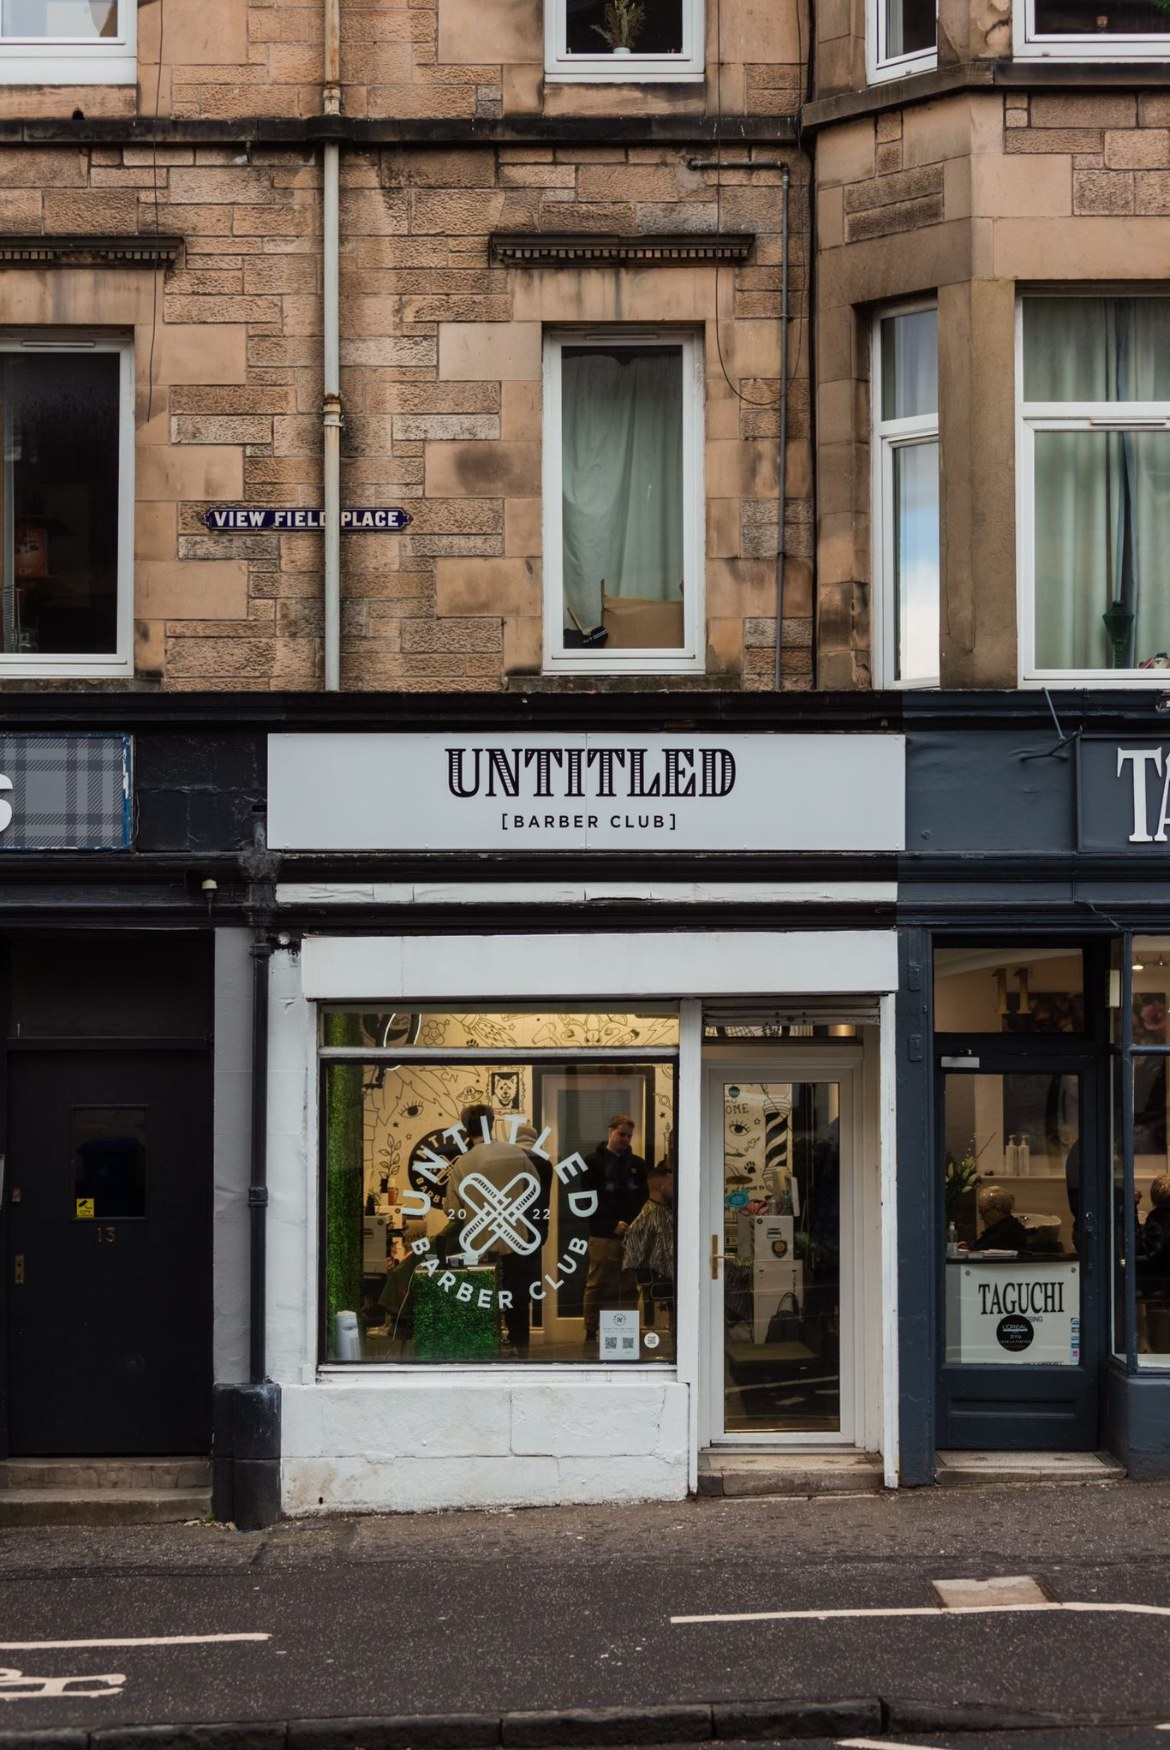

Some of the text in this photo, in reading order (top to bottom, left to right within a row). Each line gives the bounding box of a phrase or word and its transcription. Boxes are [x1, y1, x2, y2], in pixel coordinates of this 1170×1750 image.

[214, 511, 266, 527] VIEW
[341, 511, 399, 527] PLACE
[445, 748, 737, 798] UNTITLED
[401, 1115, 599, 1223] UNTITLED
[447, 1208, 550, 1220] 20 22
[96, 1227, 116, 1243] 13
[411, 1237, 588, 1309] BARBER CLUB
[978, 1282, 1064, 1314] TAGUCHI
